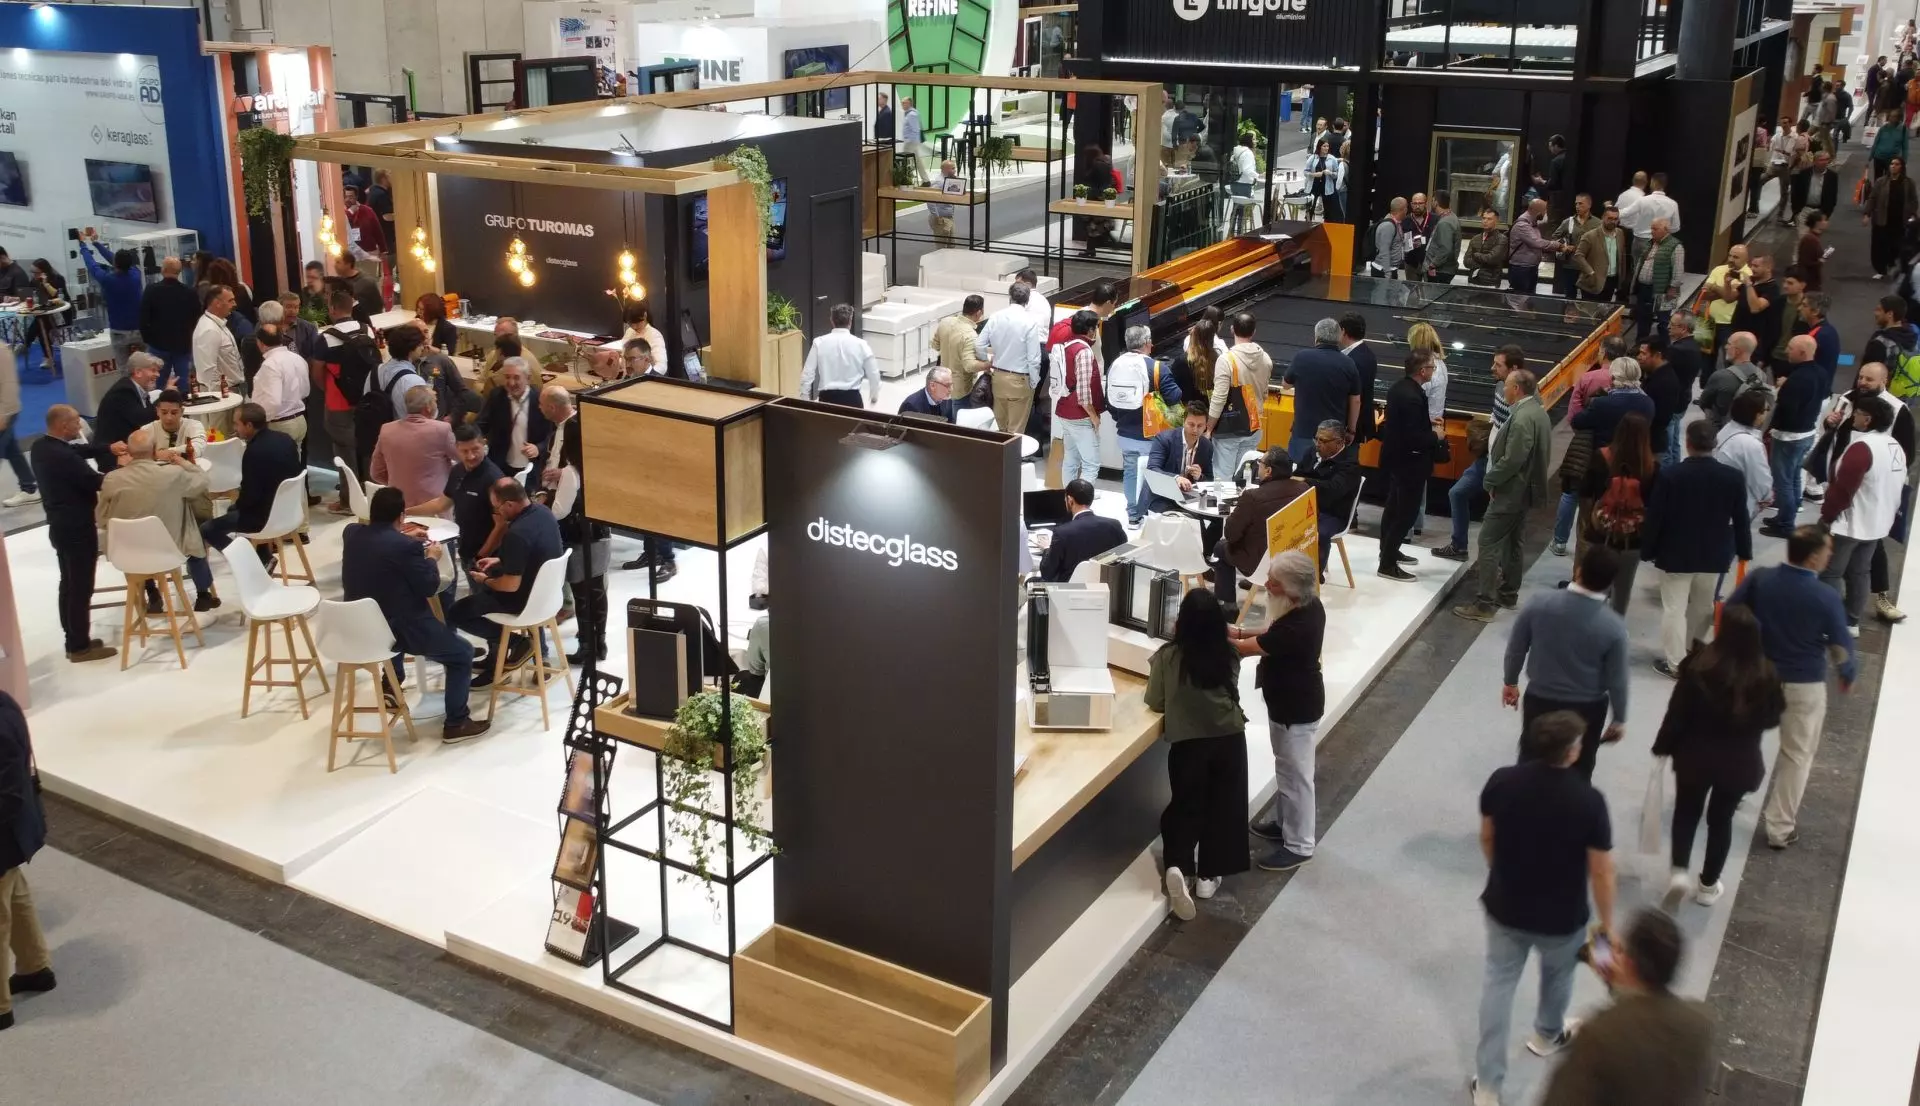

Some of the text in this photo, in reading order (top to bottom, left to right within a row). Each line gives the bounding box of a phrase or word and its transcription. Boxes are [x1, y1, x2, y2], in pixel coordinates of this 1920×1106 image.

[908, 0, 958, 17] REFINE
[140, 86, 160, 103] AD
[107, 128, 148, 146] keraglass
[484, 214, 595, 237] GRUPO TUROMAS
[545, 257, 578, 267] distecglass
[90, 359, 117, 375] TRI
[806, 516, 959, 571] distecglass
